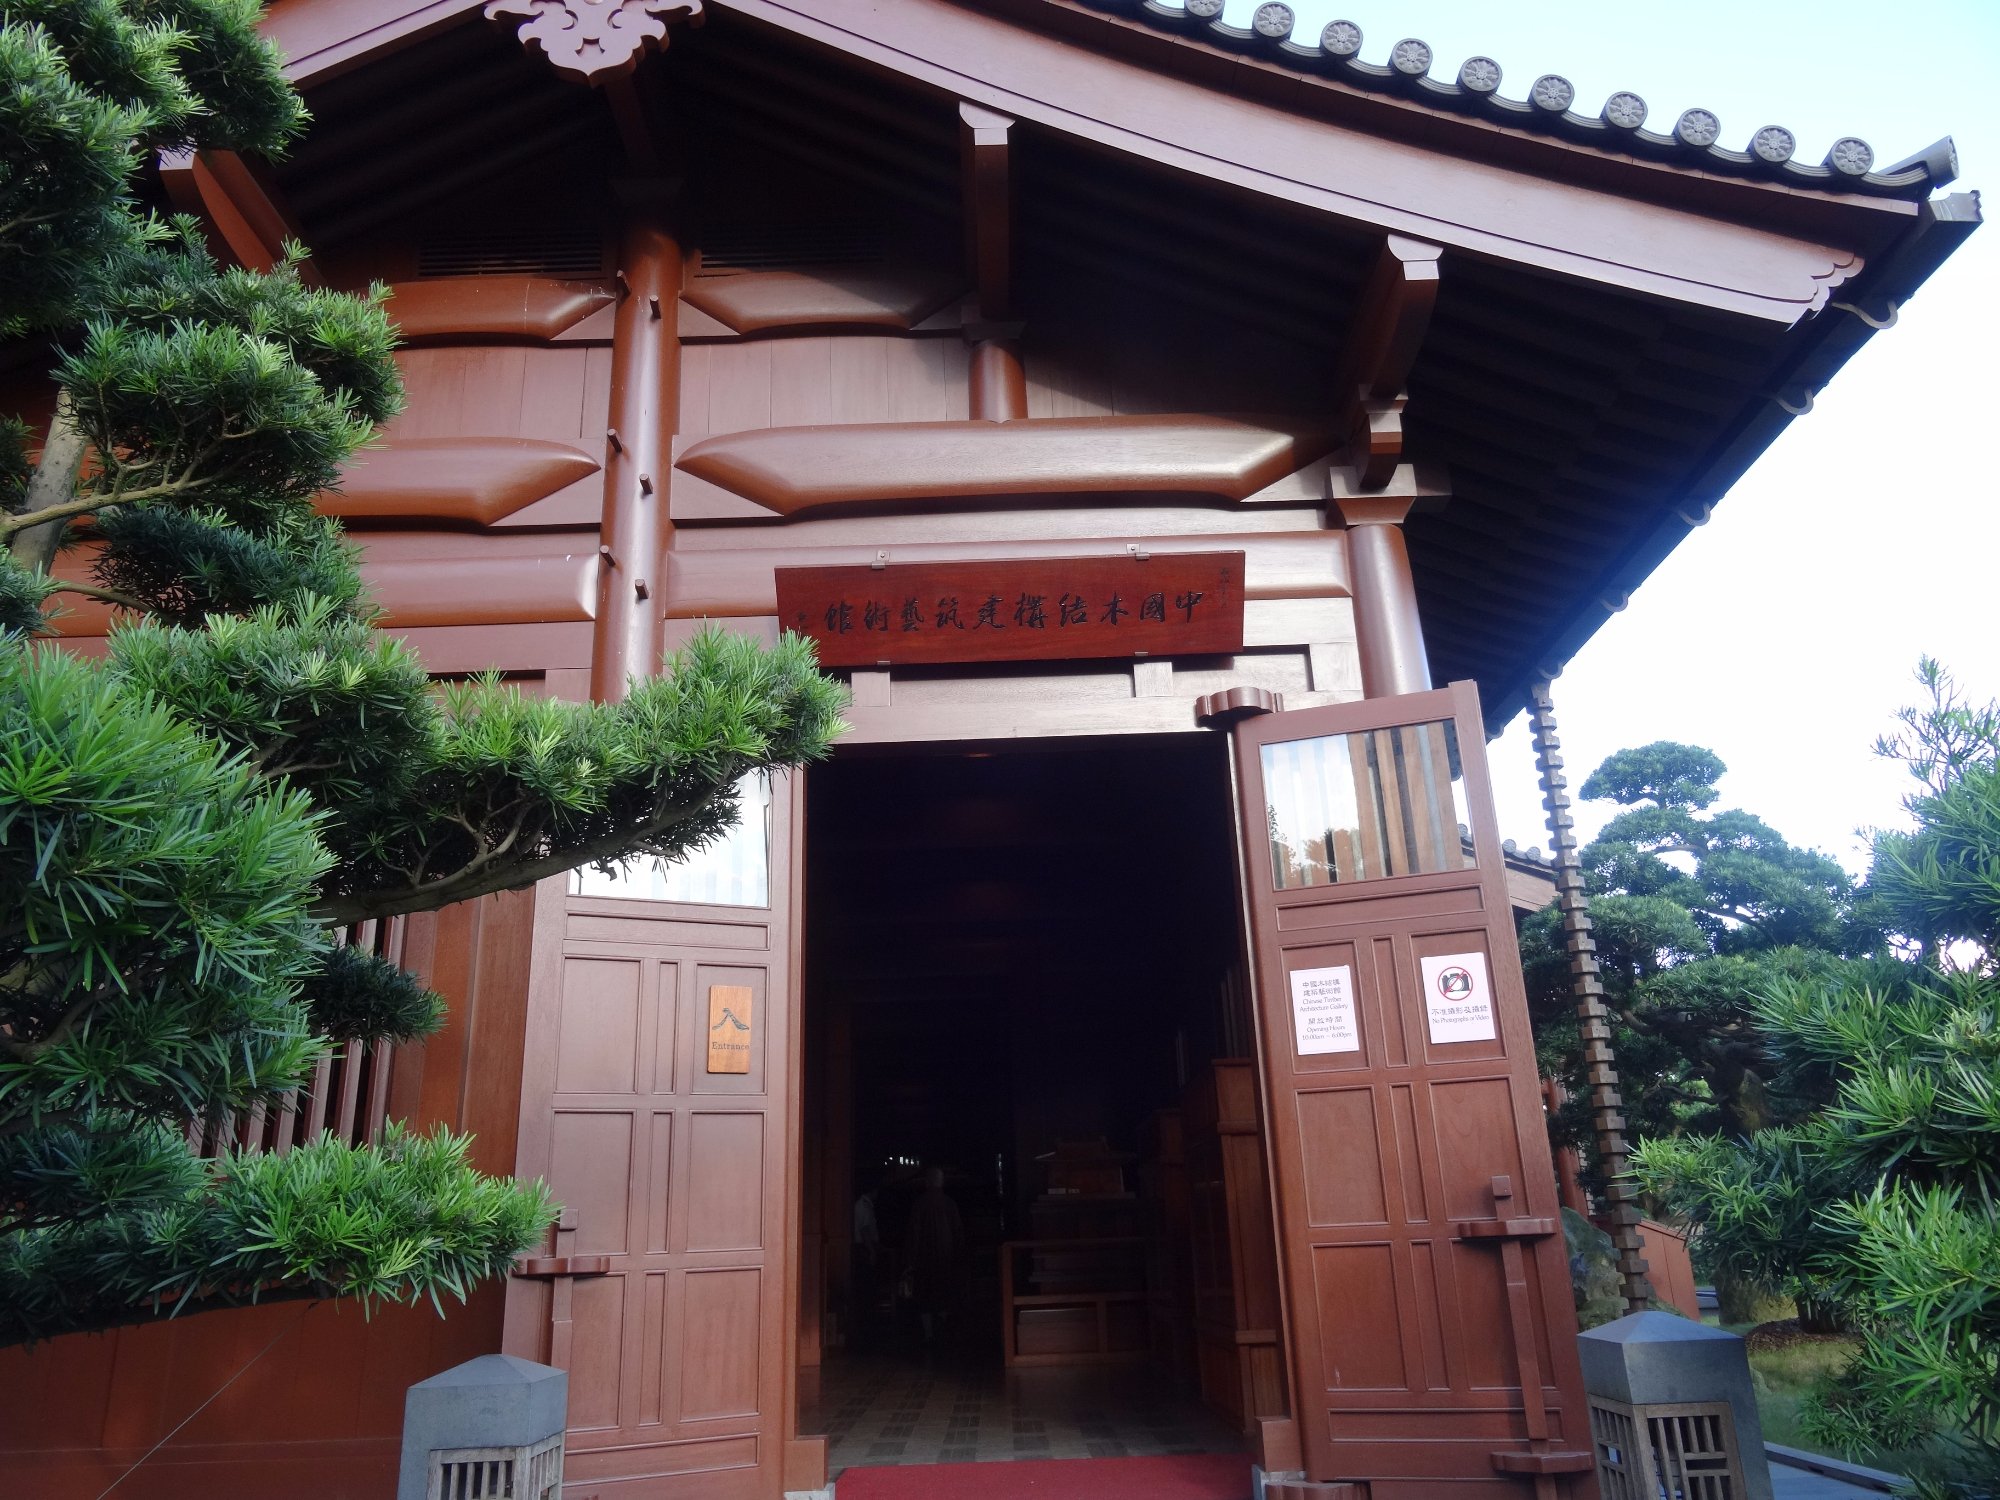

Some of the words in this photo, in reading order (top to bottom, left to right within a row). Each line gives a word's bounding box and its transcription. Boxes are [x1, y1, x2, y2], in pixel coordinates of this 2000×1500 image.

[712, 1008, 749, 1030] 入
[1308, 1016, 1342, 1024] 開放時間
[712, 1041, 750, 1050] Entrance
